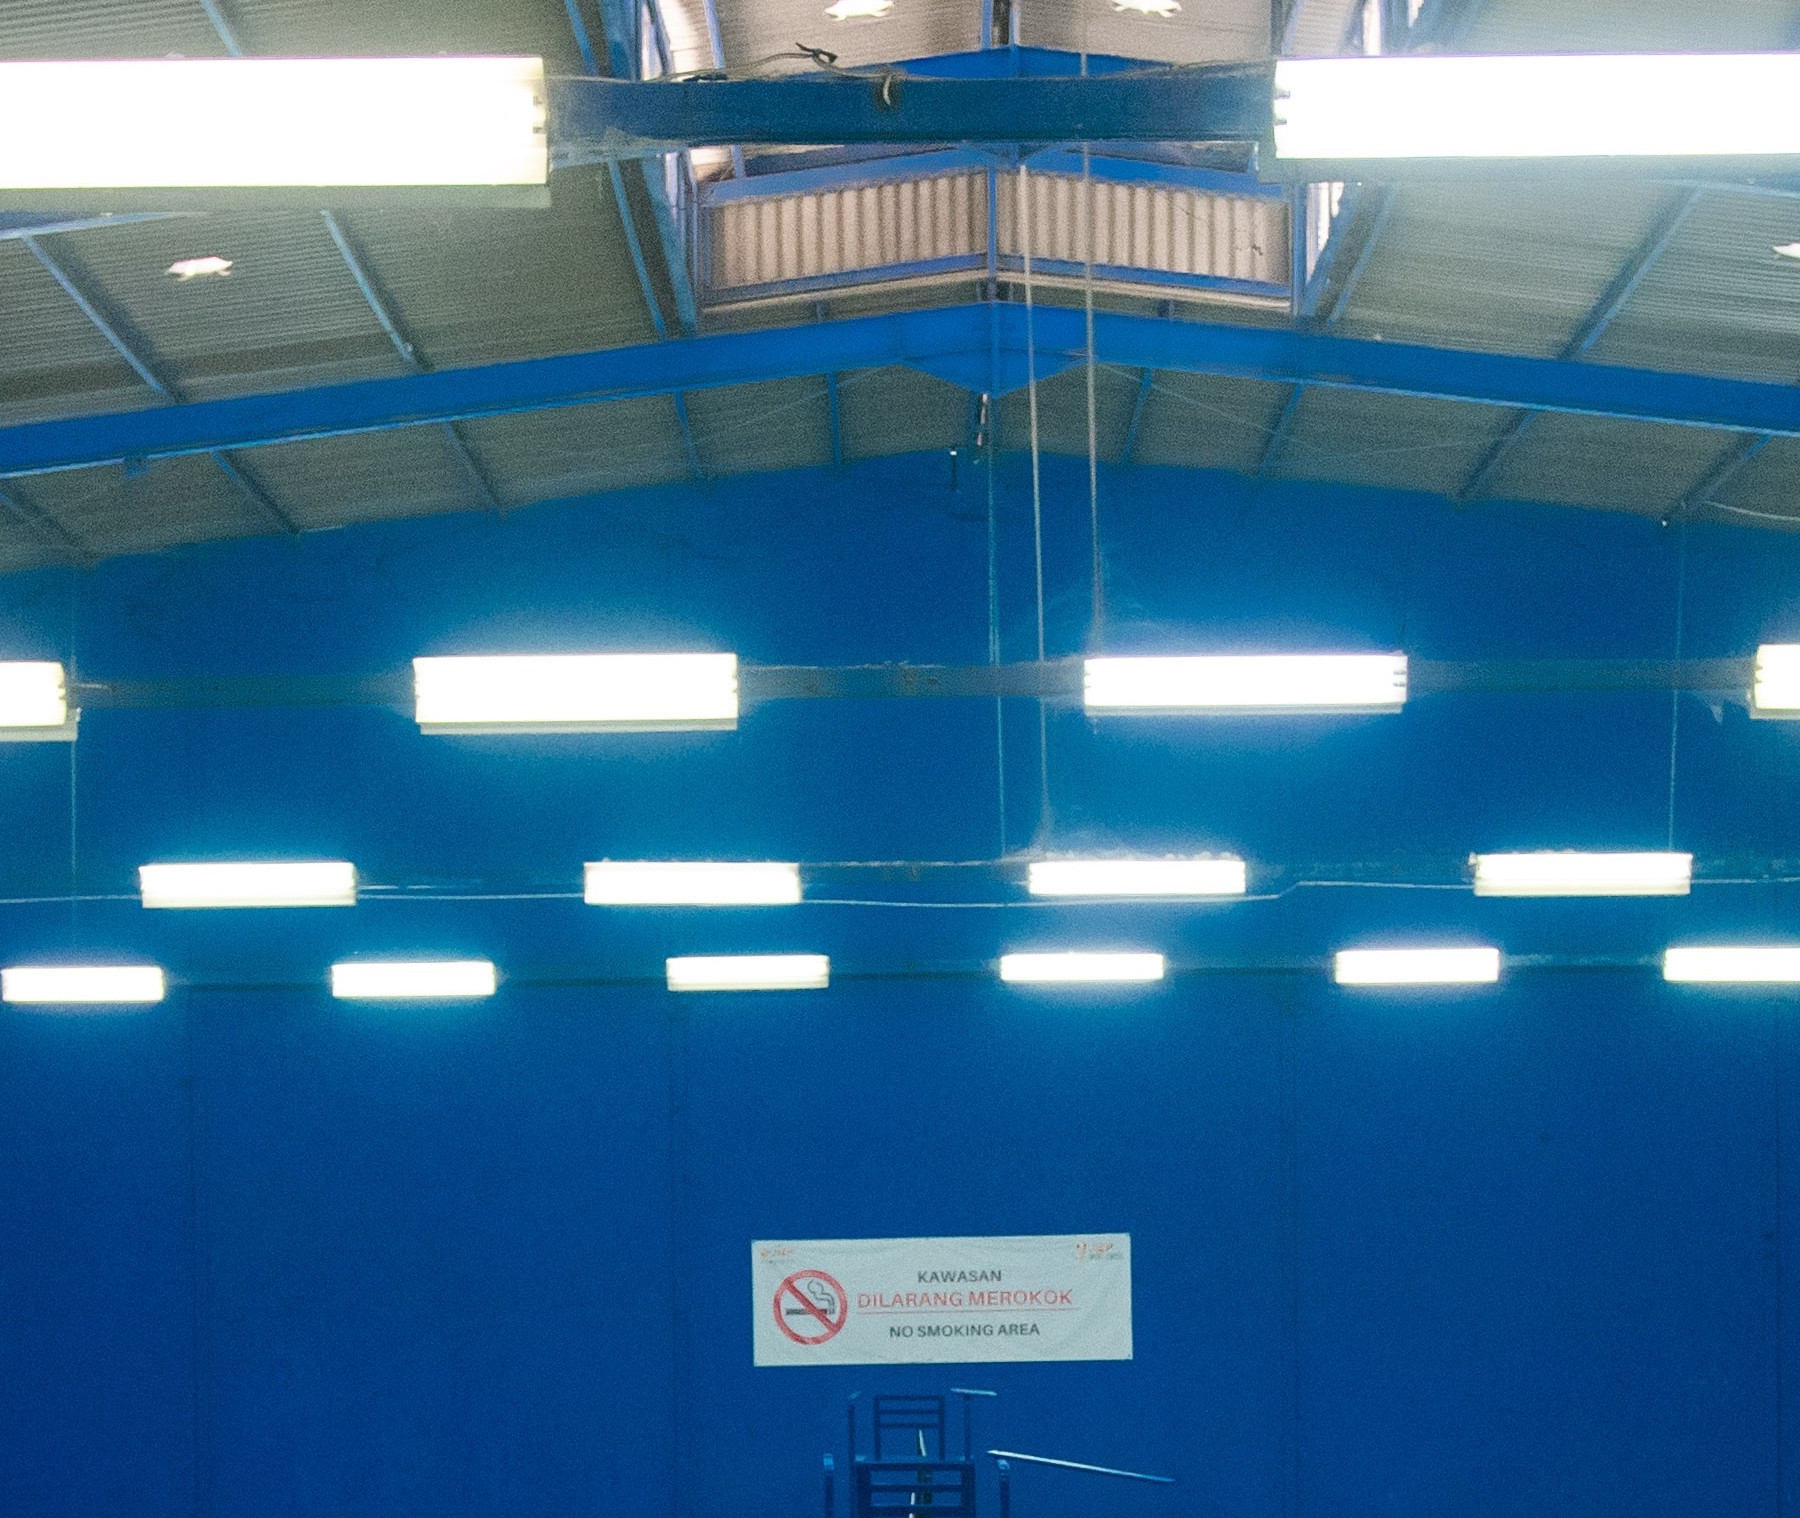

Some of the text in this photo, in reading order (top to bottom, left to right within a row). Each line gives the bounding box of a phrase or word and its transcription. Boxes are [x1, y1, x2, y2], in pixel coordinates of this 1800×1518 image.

[917, 1270, 1002, 1284] KAWASAN
[856, 1288, 1073, 1308] DILARANG MEROKOK
[889, 1323, 1040, 1338] NO SMOKING AREA
